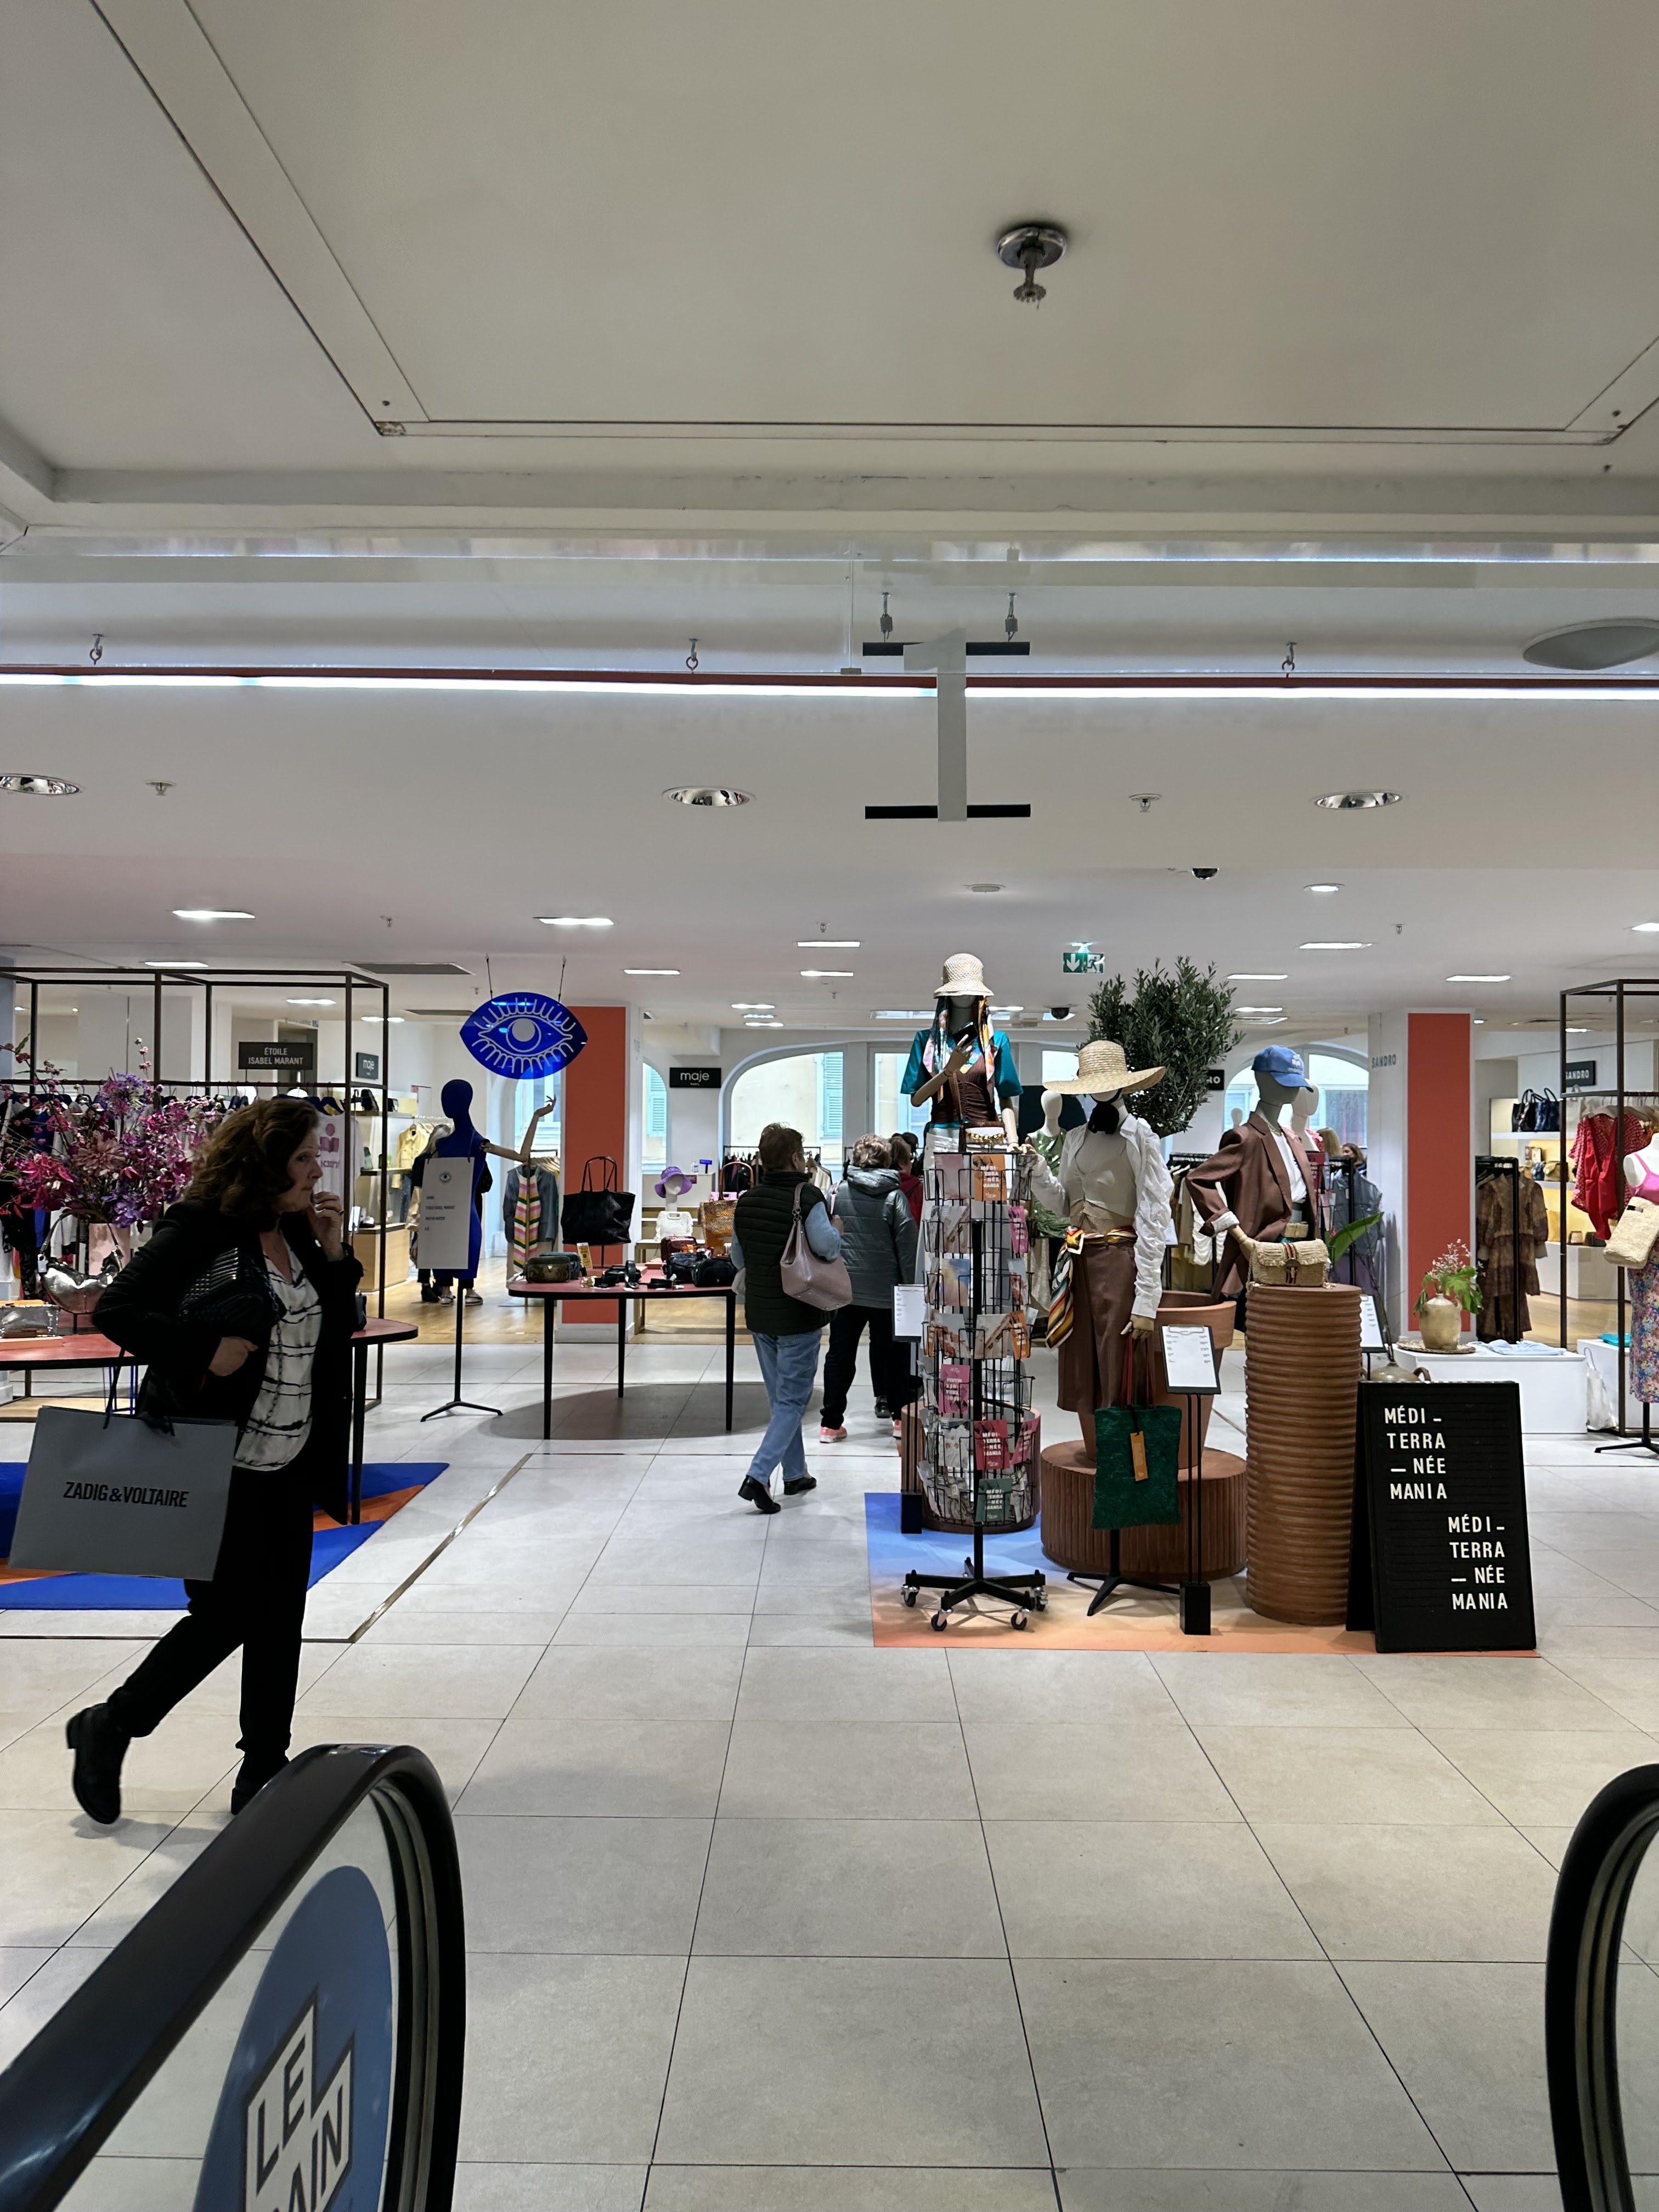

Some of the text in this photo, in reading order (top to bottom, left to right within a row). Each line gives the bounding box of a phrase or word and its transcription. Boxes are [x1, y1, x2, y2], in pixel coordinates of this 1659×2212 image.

[264, 1047, 287, 1056] ÉTOILE
[248, 1057, 273, 1065] ISABEL
[363, 1059, 374, 1071] maje
[1372, 1053, 1396, 1069] SANDRO
[680, 1070, 709, 1082] maje
[1386, 1432, 1446, 1449] TERRA
[63, 1481, 189, 1508] ZADIG&VOLTAIRE
[1390, 1483, 1447, 1499] MANIA
[1449, 1542, 1505, 1559] TERRA
[1452, 1593, 1508, 1610] MANIA
[256, 2033, 306, 2196] LE
